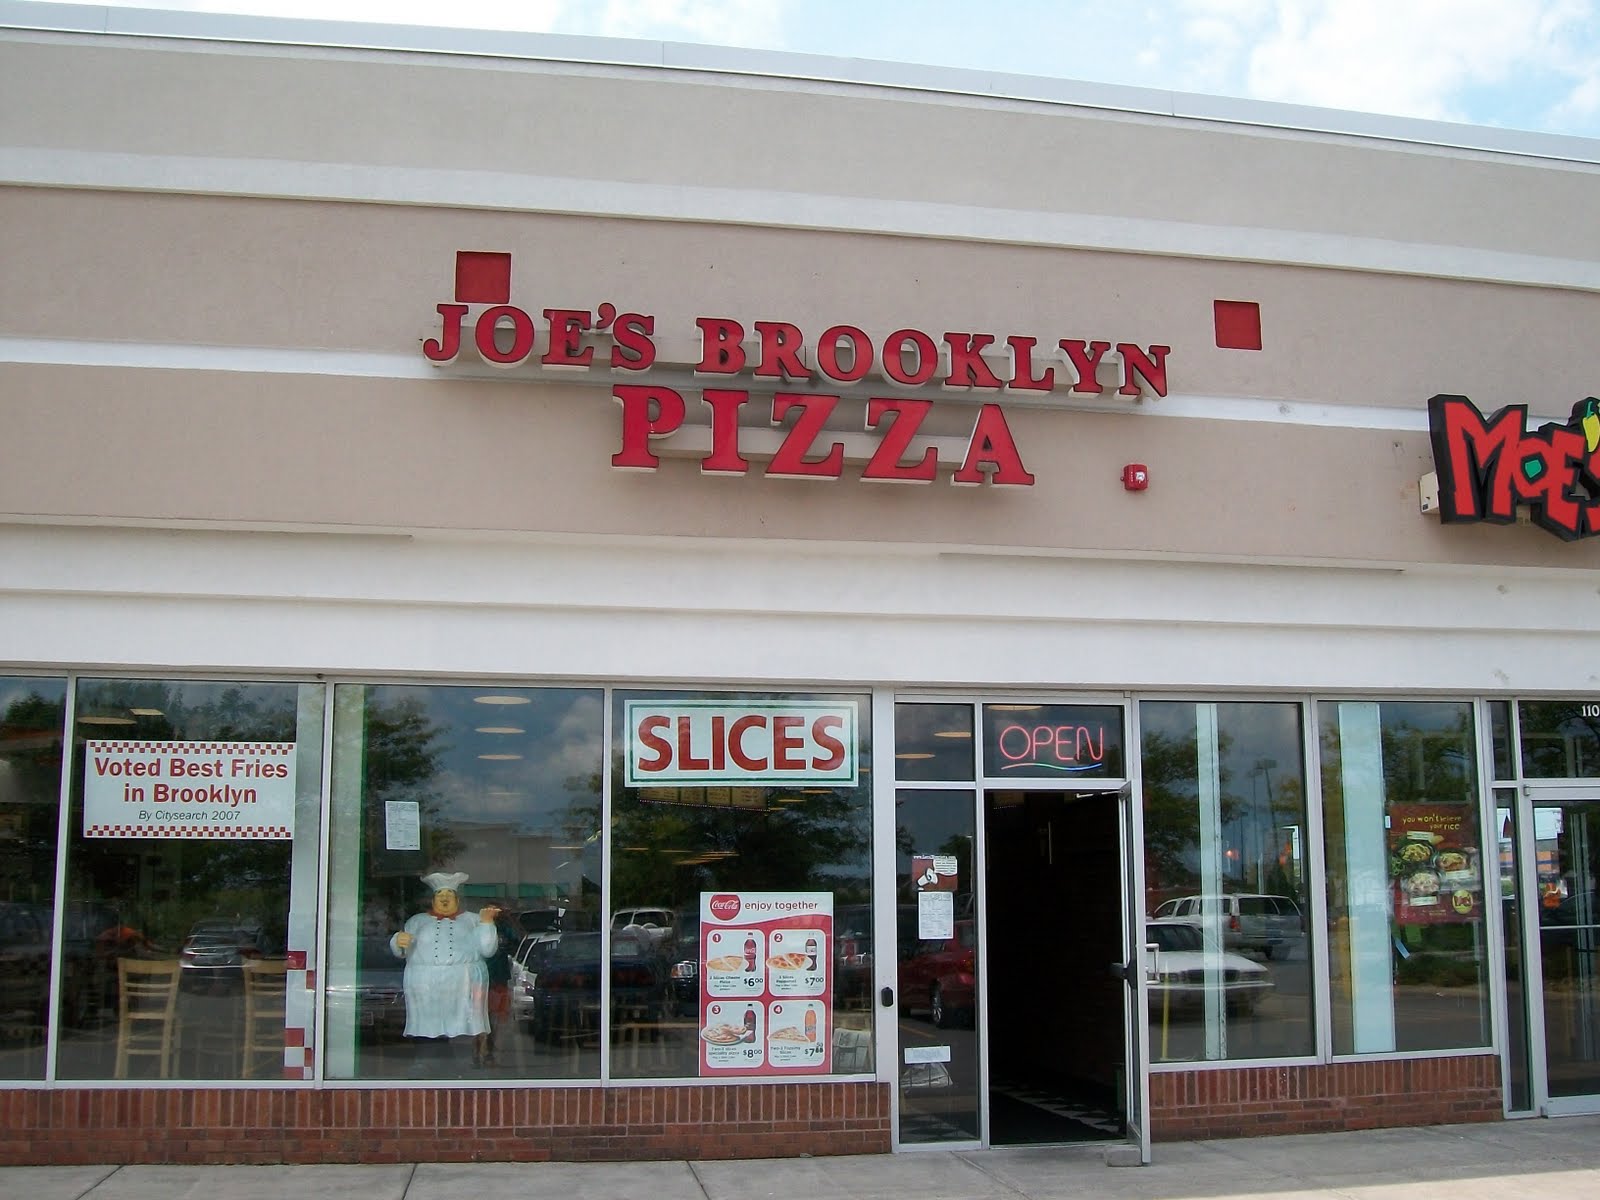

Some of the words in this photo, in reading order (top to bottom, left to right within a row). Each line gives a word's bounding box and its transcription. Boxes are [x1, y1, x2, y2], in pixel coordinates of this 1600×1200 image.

[423, 302, 656, 371] JOE'S
[695, 317, 1171, 399] BROOKLYN
[612, 385, 1036, 488] PIZZA
[638, 714, 846, 771] SLICES
[999, 725, 1104, 761] OPEN
[94, 757, 161, 777] Voted
[169, 757, 223, 778] Best
[231, 758, 288, 778] Fries
[124, 783, 144, 802] in
[153, 783, 257, 807] Brooklyn
[138, 810, 152, 821] By
[155, 810, 208, 821] Citysearch
[212, 811, 241, 820] 2007
[744, 901, 772, 911] enjoy
[775, 901, 818, 911] together
